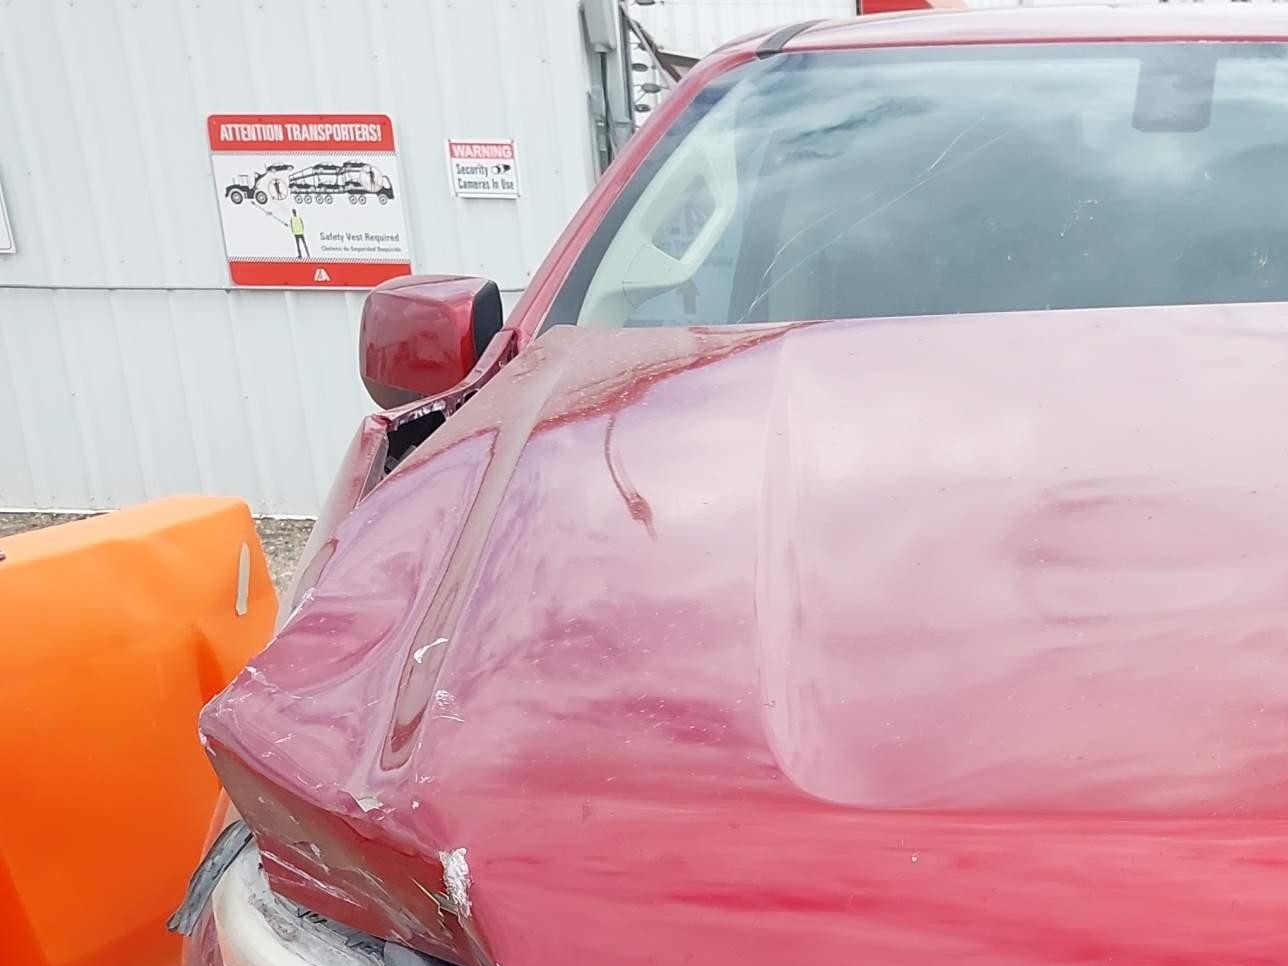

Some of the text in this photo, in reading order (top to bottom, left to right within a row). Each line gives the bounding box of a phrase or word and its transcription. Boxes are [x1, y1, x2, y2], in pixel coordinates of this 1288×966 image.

[220, 124, 382, 142] ATTENTION TRANSPORTERS!
[453, 145, 512, 158] WARNING
[456, 163, 488, 177] Security
[458, 178, 490, 190] Cameras
[501, 178, 514, 190] Use
[320, 232, 399, 243] Safety Vest Required
